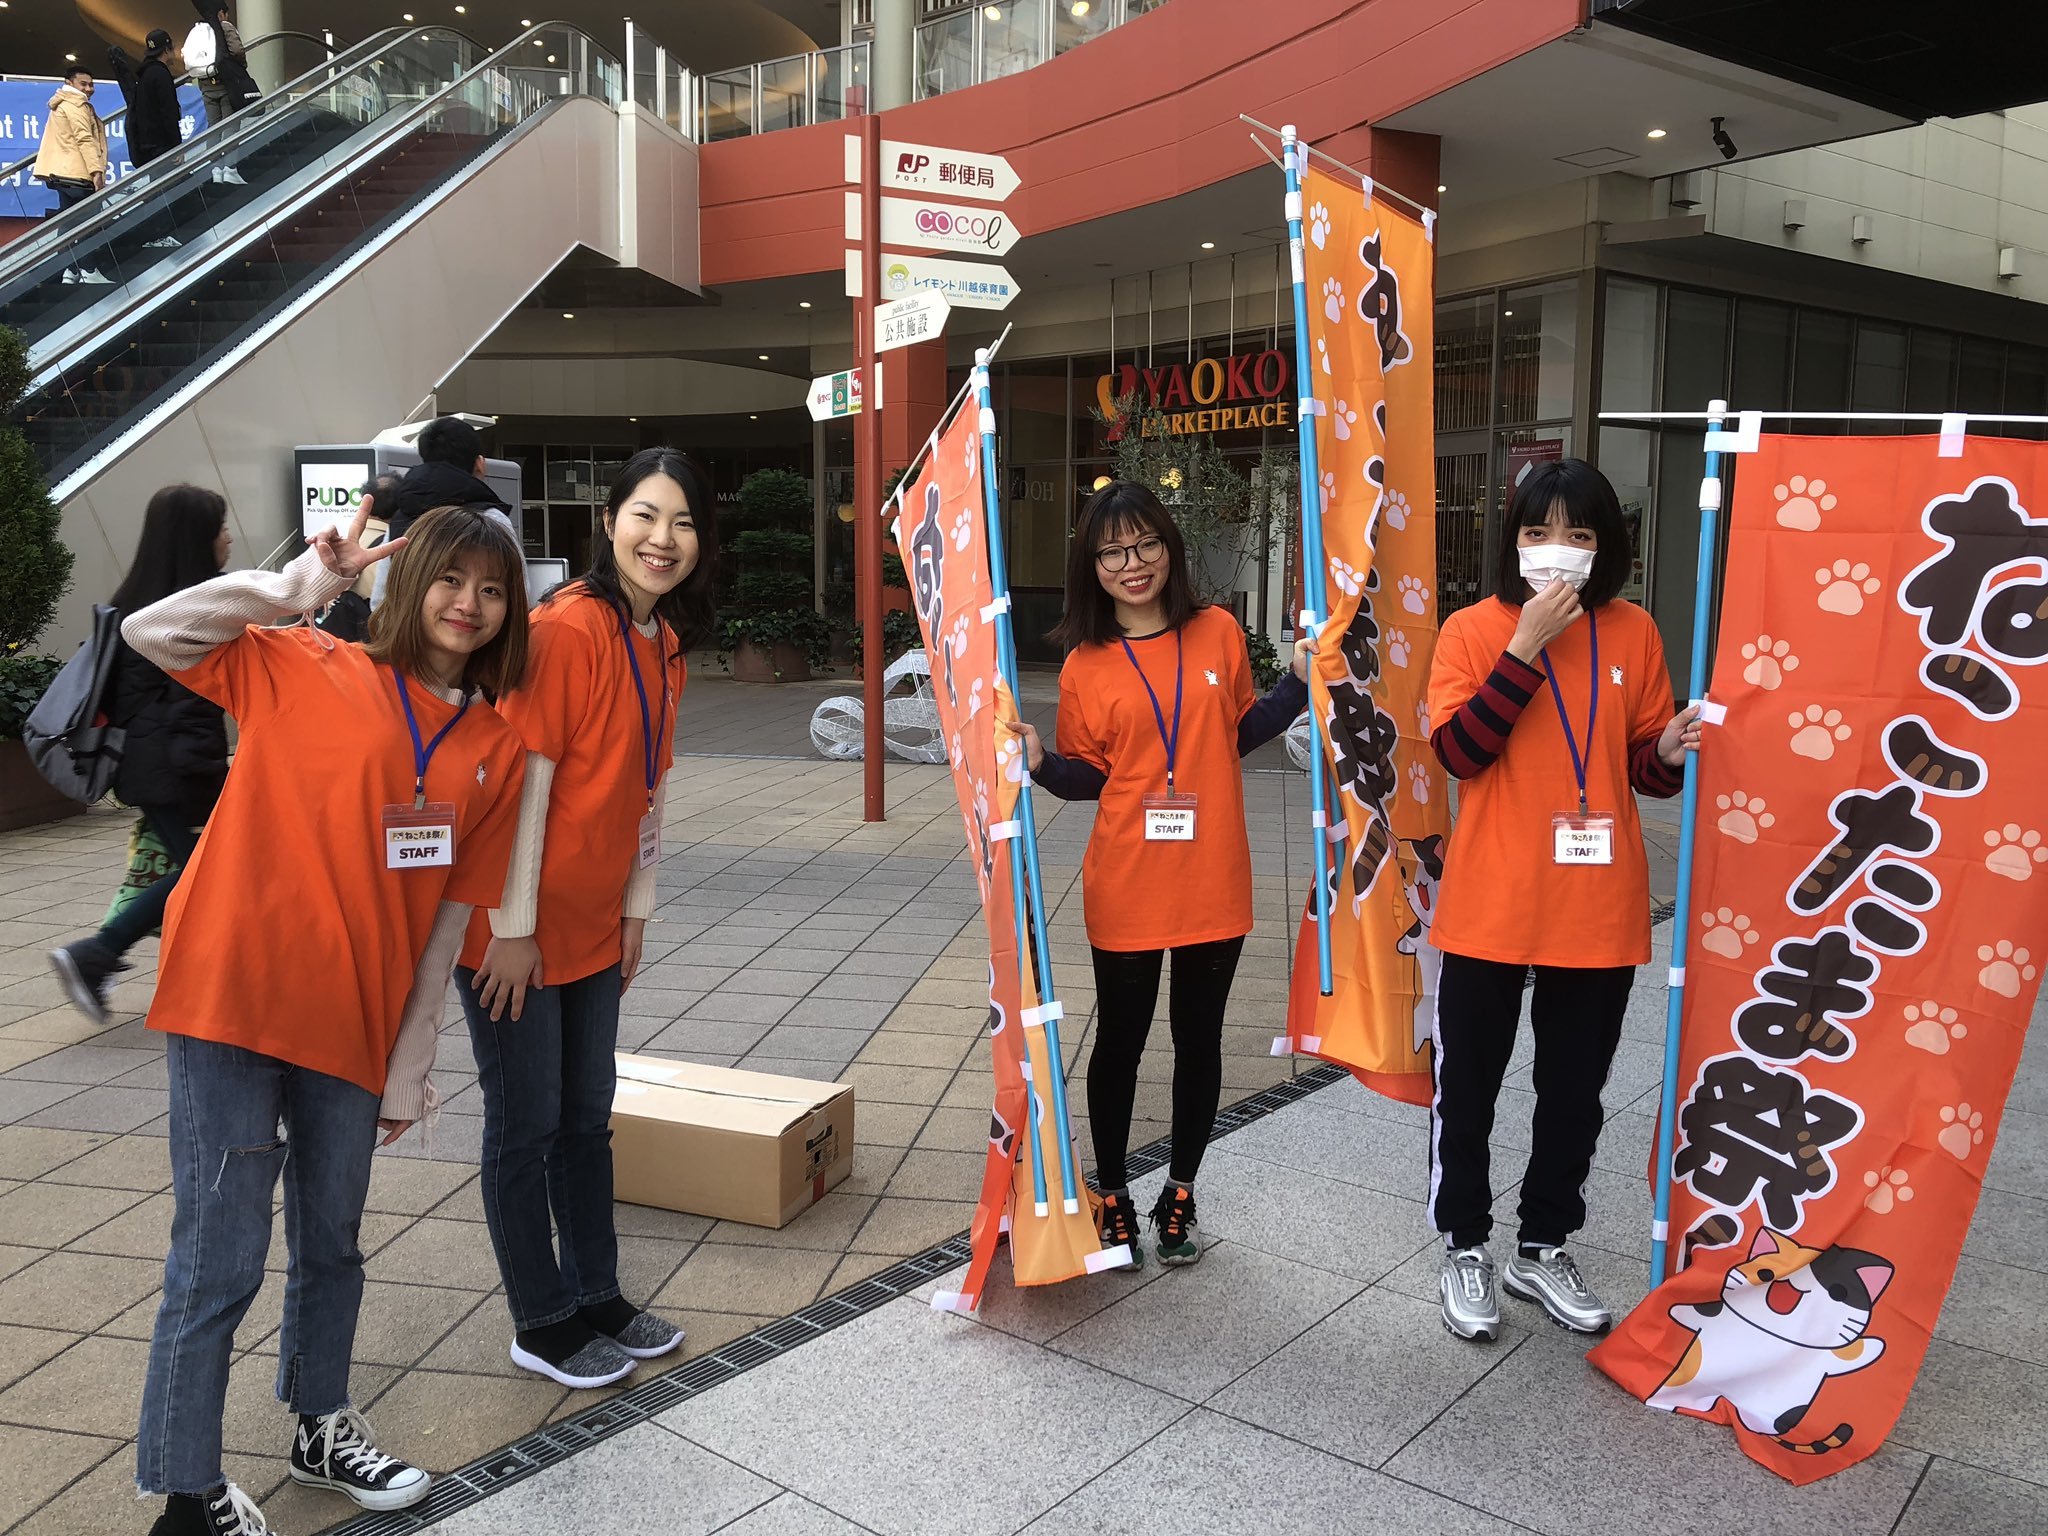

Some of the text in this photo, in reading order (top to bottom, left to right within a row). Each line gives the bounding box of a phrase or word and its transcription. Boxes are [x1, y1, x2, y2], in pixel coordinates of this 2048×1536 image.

[23, 114, 40, 139] it
[895, 174, 927, 184] POST
[938, 162, 995, 189] 郵便局
[885, 312, 928, 343] 公共施設
[1142, 349, 1289, 409] YAOKO
[1141, 402, 1290, 438] MARKETPLACE
[306, 486, 363, 507] PUDO
[405, 830, 445, 840] ねこたま祭!
[1154, 825, 1185, 834] STAFF
[399, 846, 439, 860] STAFF
[1565, 847, 1600, 857] STAFF
